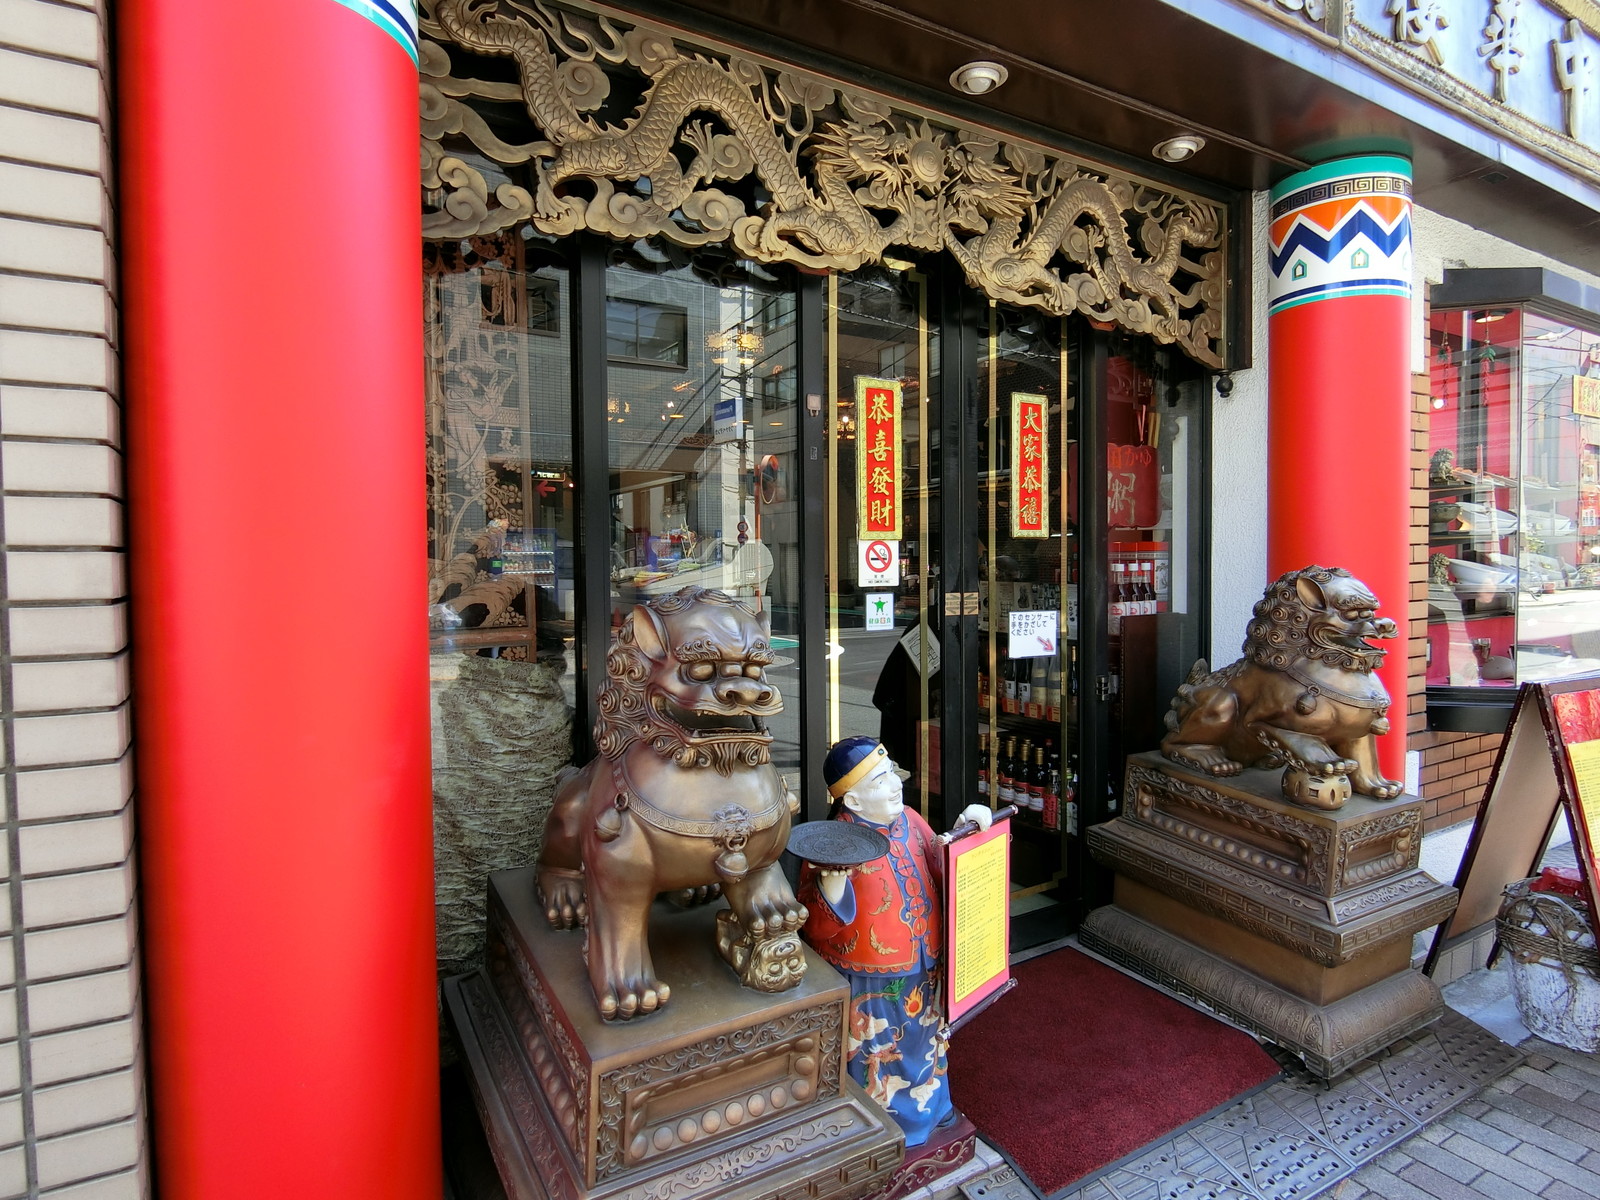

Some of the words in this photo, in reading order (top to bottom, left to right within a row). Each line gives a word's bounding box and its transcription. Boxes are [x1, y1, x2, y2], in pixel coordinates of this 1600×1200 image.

[868, 393, 893, 526] 恭喜發財
[1020, 407, 1042, 525] 大家恭禧
[1011, 613, 1055, 623] 下のセンサーに
[1011, 621, 1047, 631] 手をかざして
